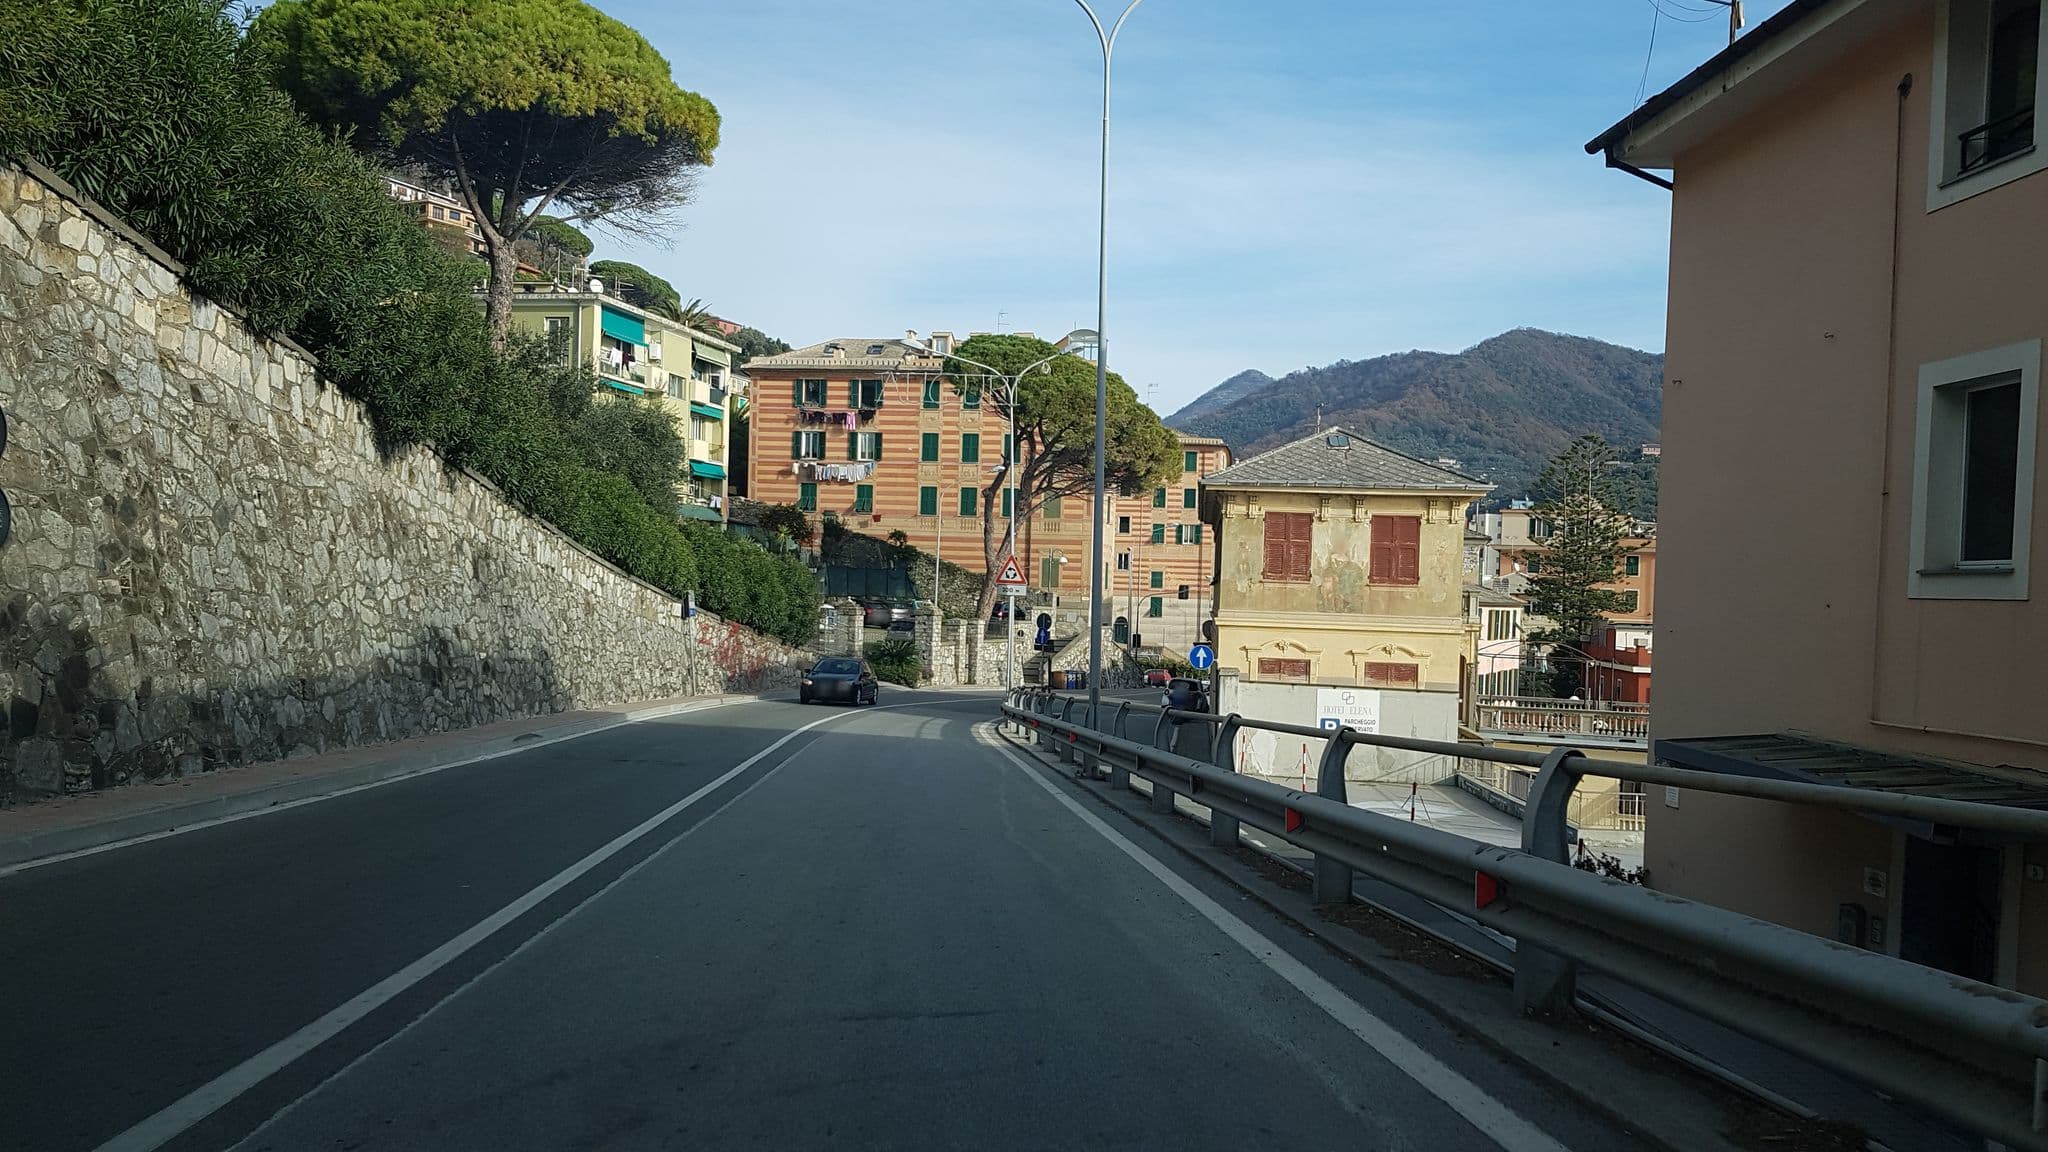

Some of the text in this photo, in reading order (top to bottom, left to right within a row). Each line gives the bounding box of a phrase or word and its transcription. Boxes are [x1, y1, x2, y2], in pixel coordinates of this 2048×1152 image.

[1323, 705, 1372, 715] HOTEL ELENA
[1344, 718, 1376, 726] PARCHEGGIO
